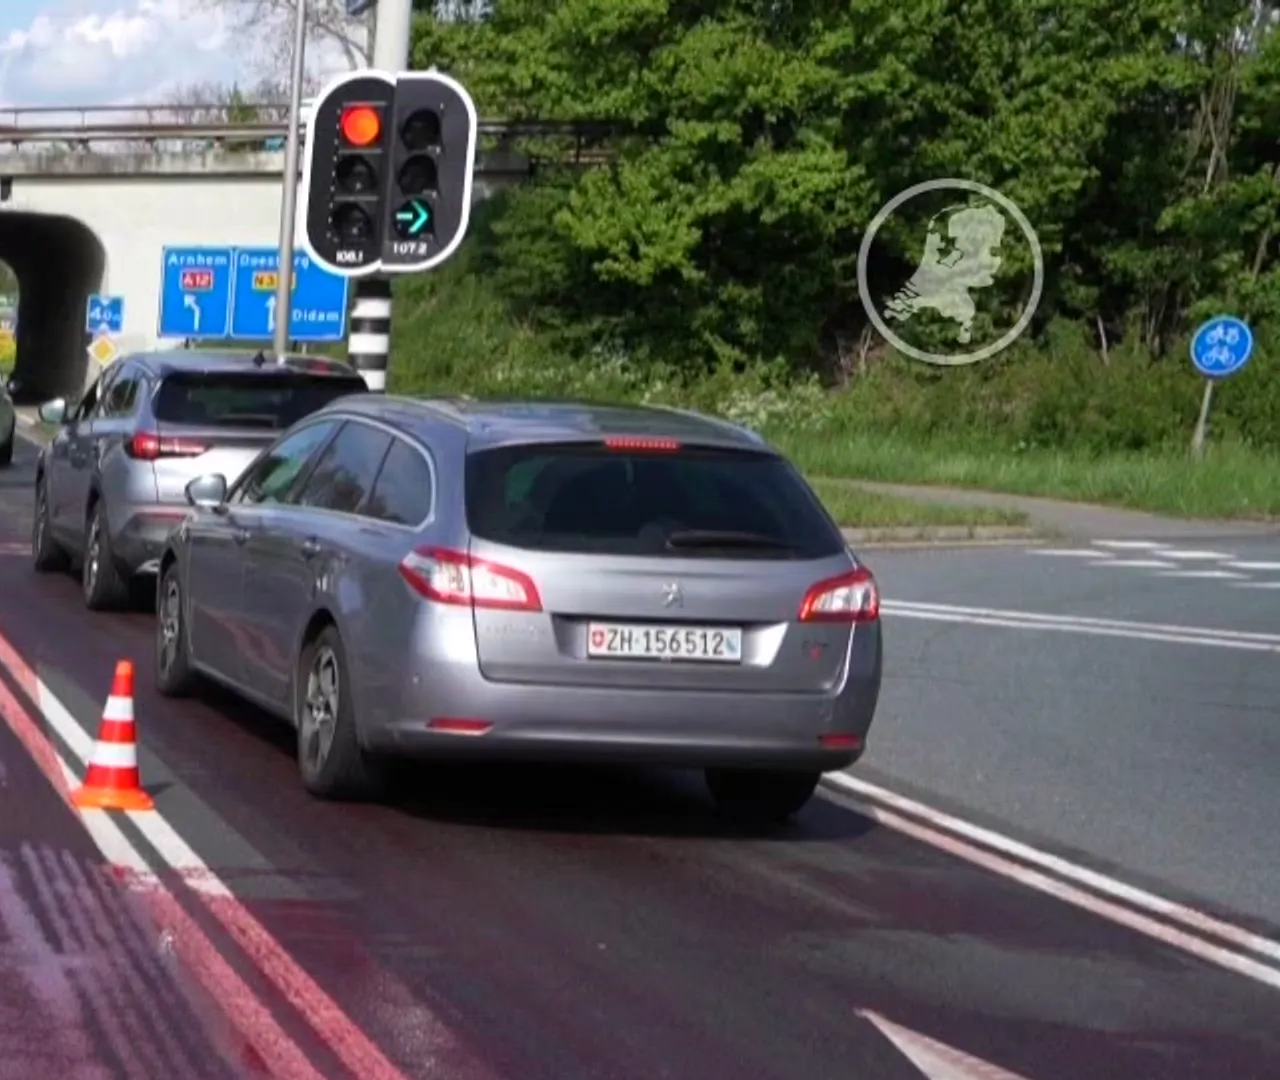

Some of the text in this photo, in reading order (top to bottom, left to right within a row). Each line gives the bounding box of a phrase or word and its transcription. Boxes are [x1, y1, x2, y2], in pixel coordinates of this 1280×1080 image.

[168, 253, 228, 266] Arnhem
[182, 274, 210, 290] A12
[292, 310, 339, 324] Didam
